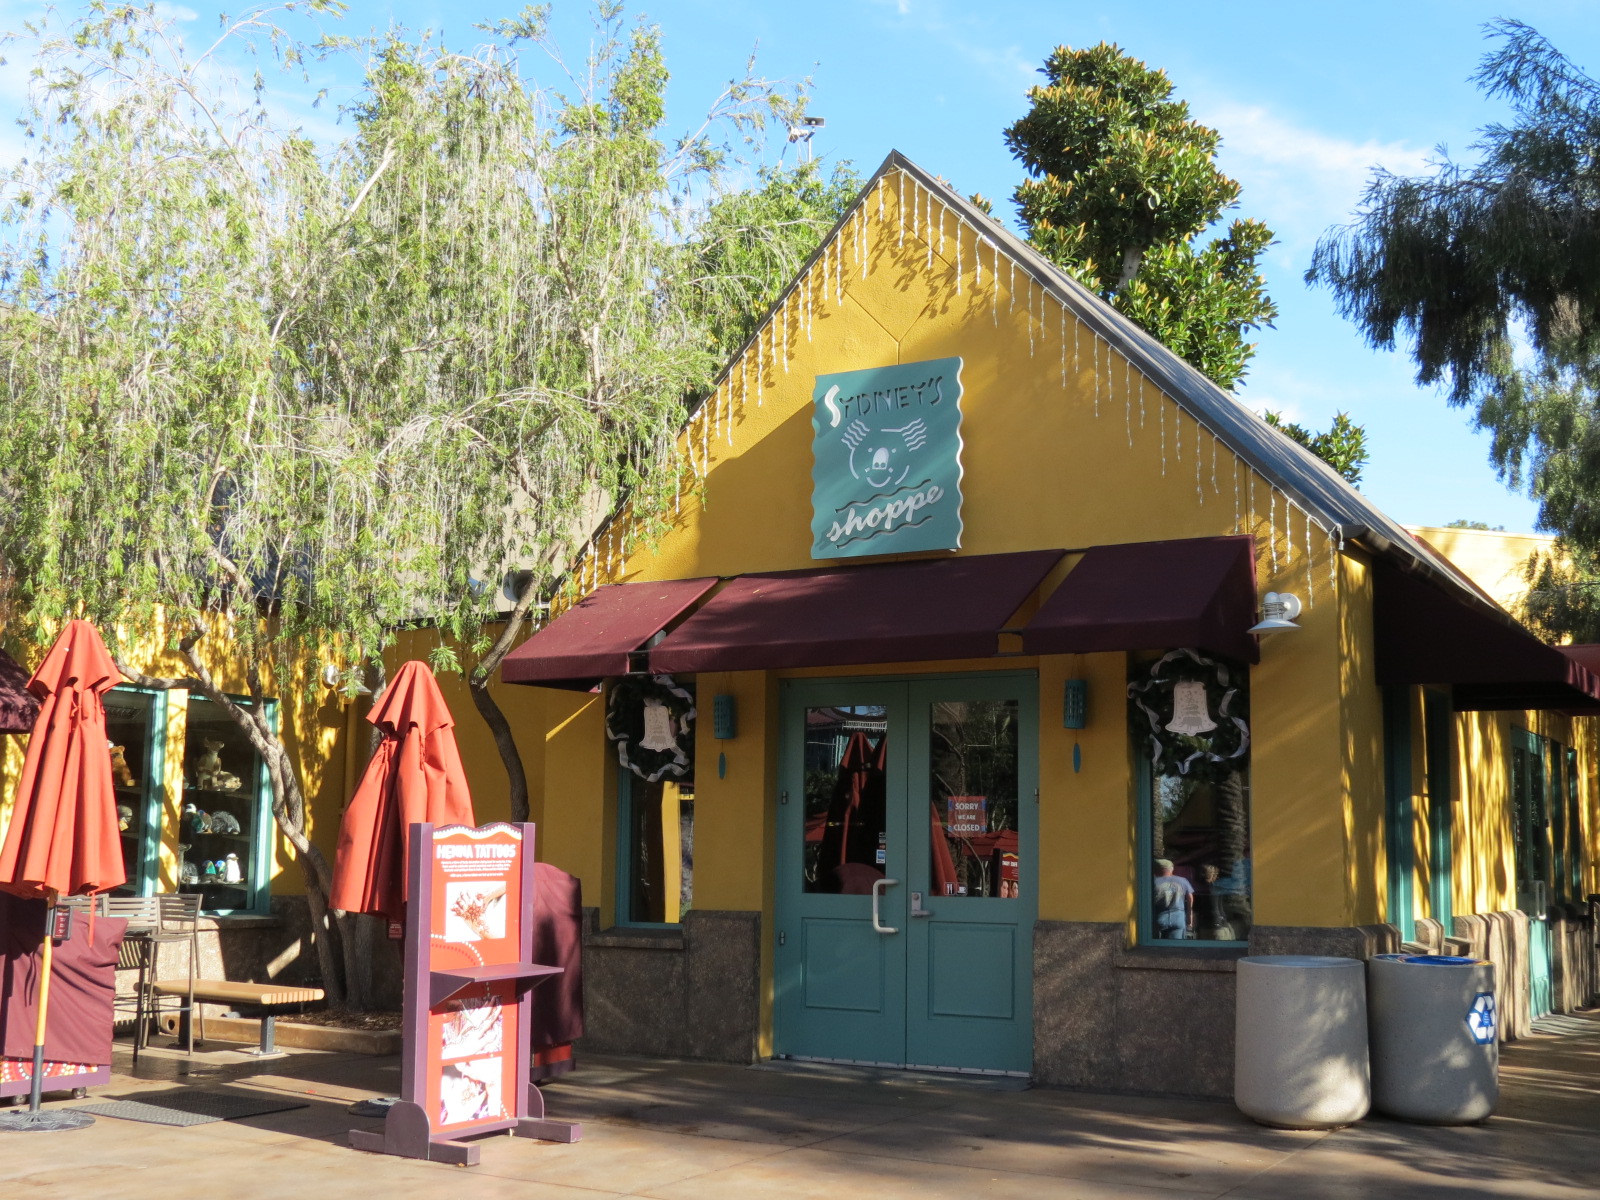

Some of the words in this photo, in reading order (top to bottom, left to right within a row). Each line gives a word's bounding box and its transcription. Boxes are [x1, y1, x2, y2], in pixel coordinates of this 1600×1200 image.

[826, 485, 945, 542] shoppe
[436, 844, 473, 859] HENNA
[474, 844, 516, 859] TATTOOS
